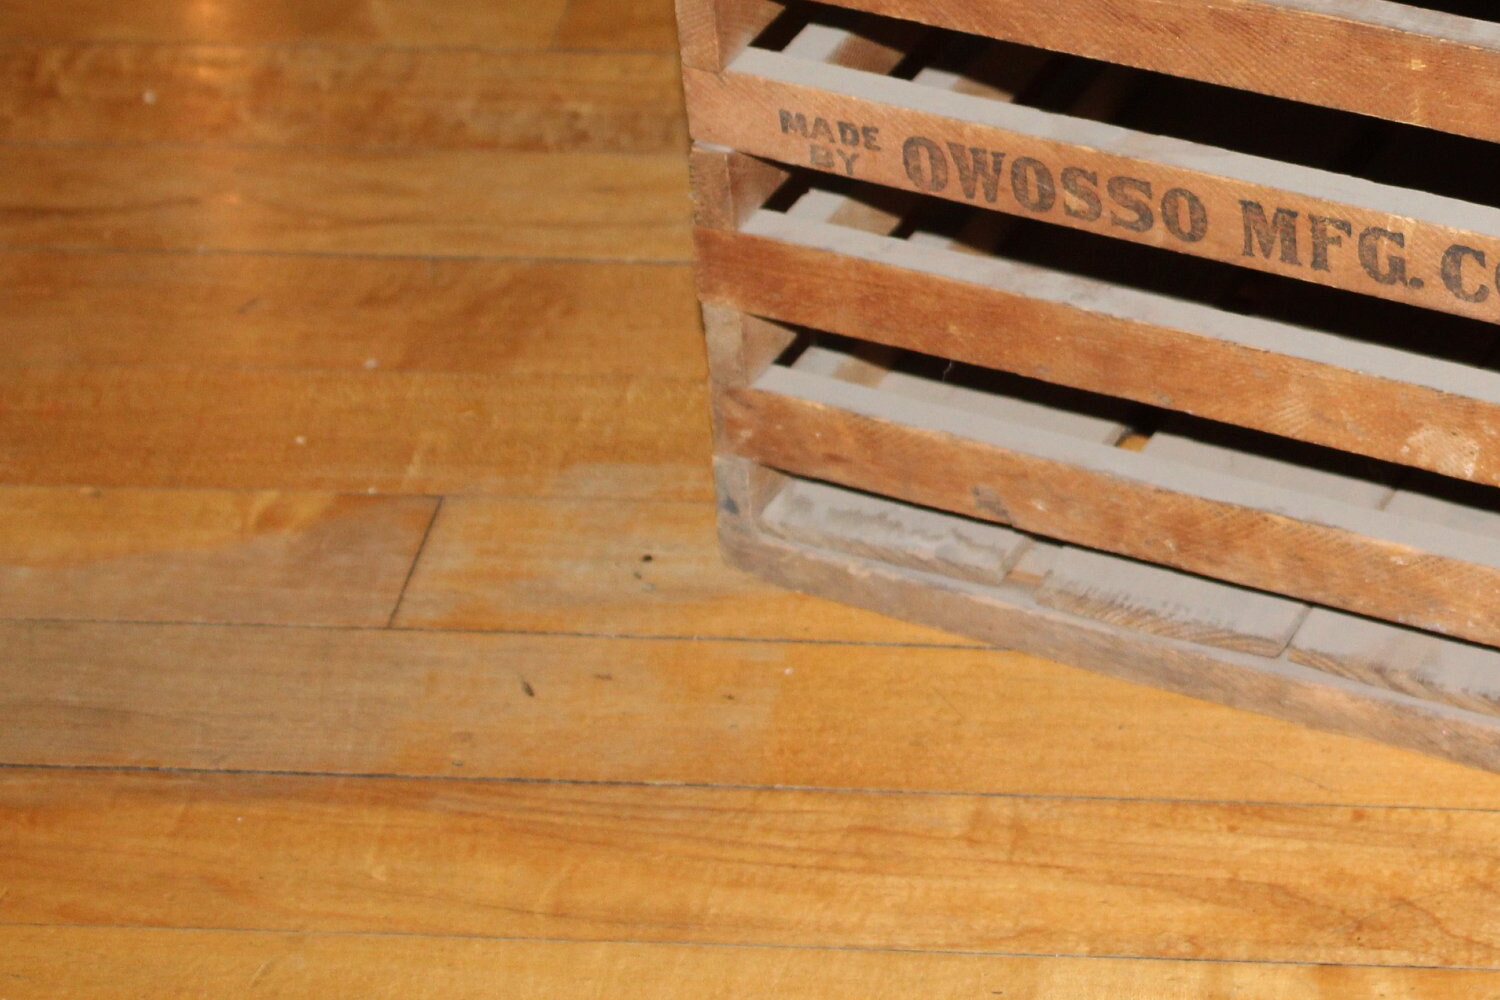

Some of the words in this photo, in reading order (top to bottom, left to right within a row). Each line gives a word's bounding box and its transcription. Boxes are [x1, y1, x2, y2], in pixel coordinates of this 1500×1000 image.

[778, 108, 882, 152] MADE
[808, 144, 860, 177] BY
[902, 135, 1208, 243] OWOSSO
